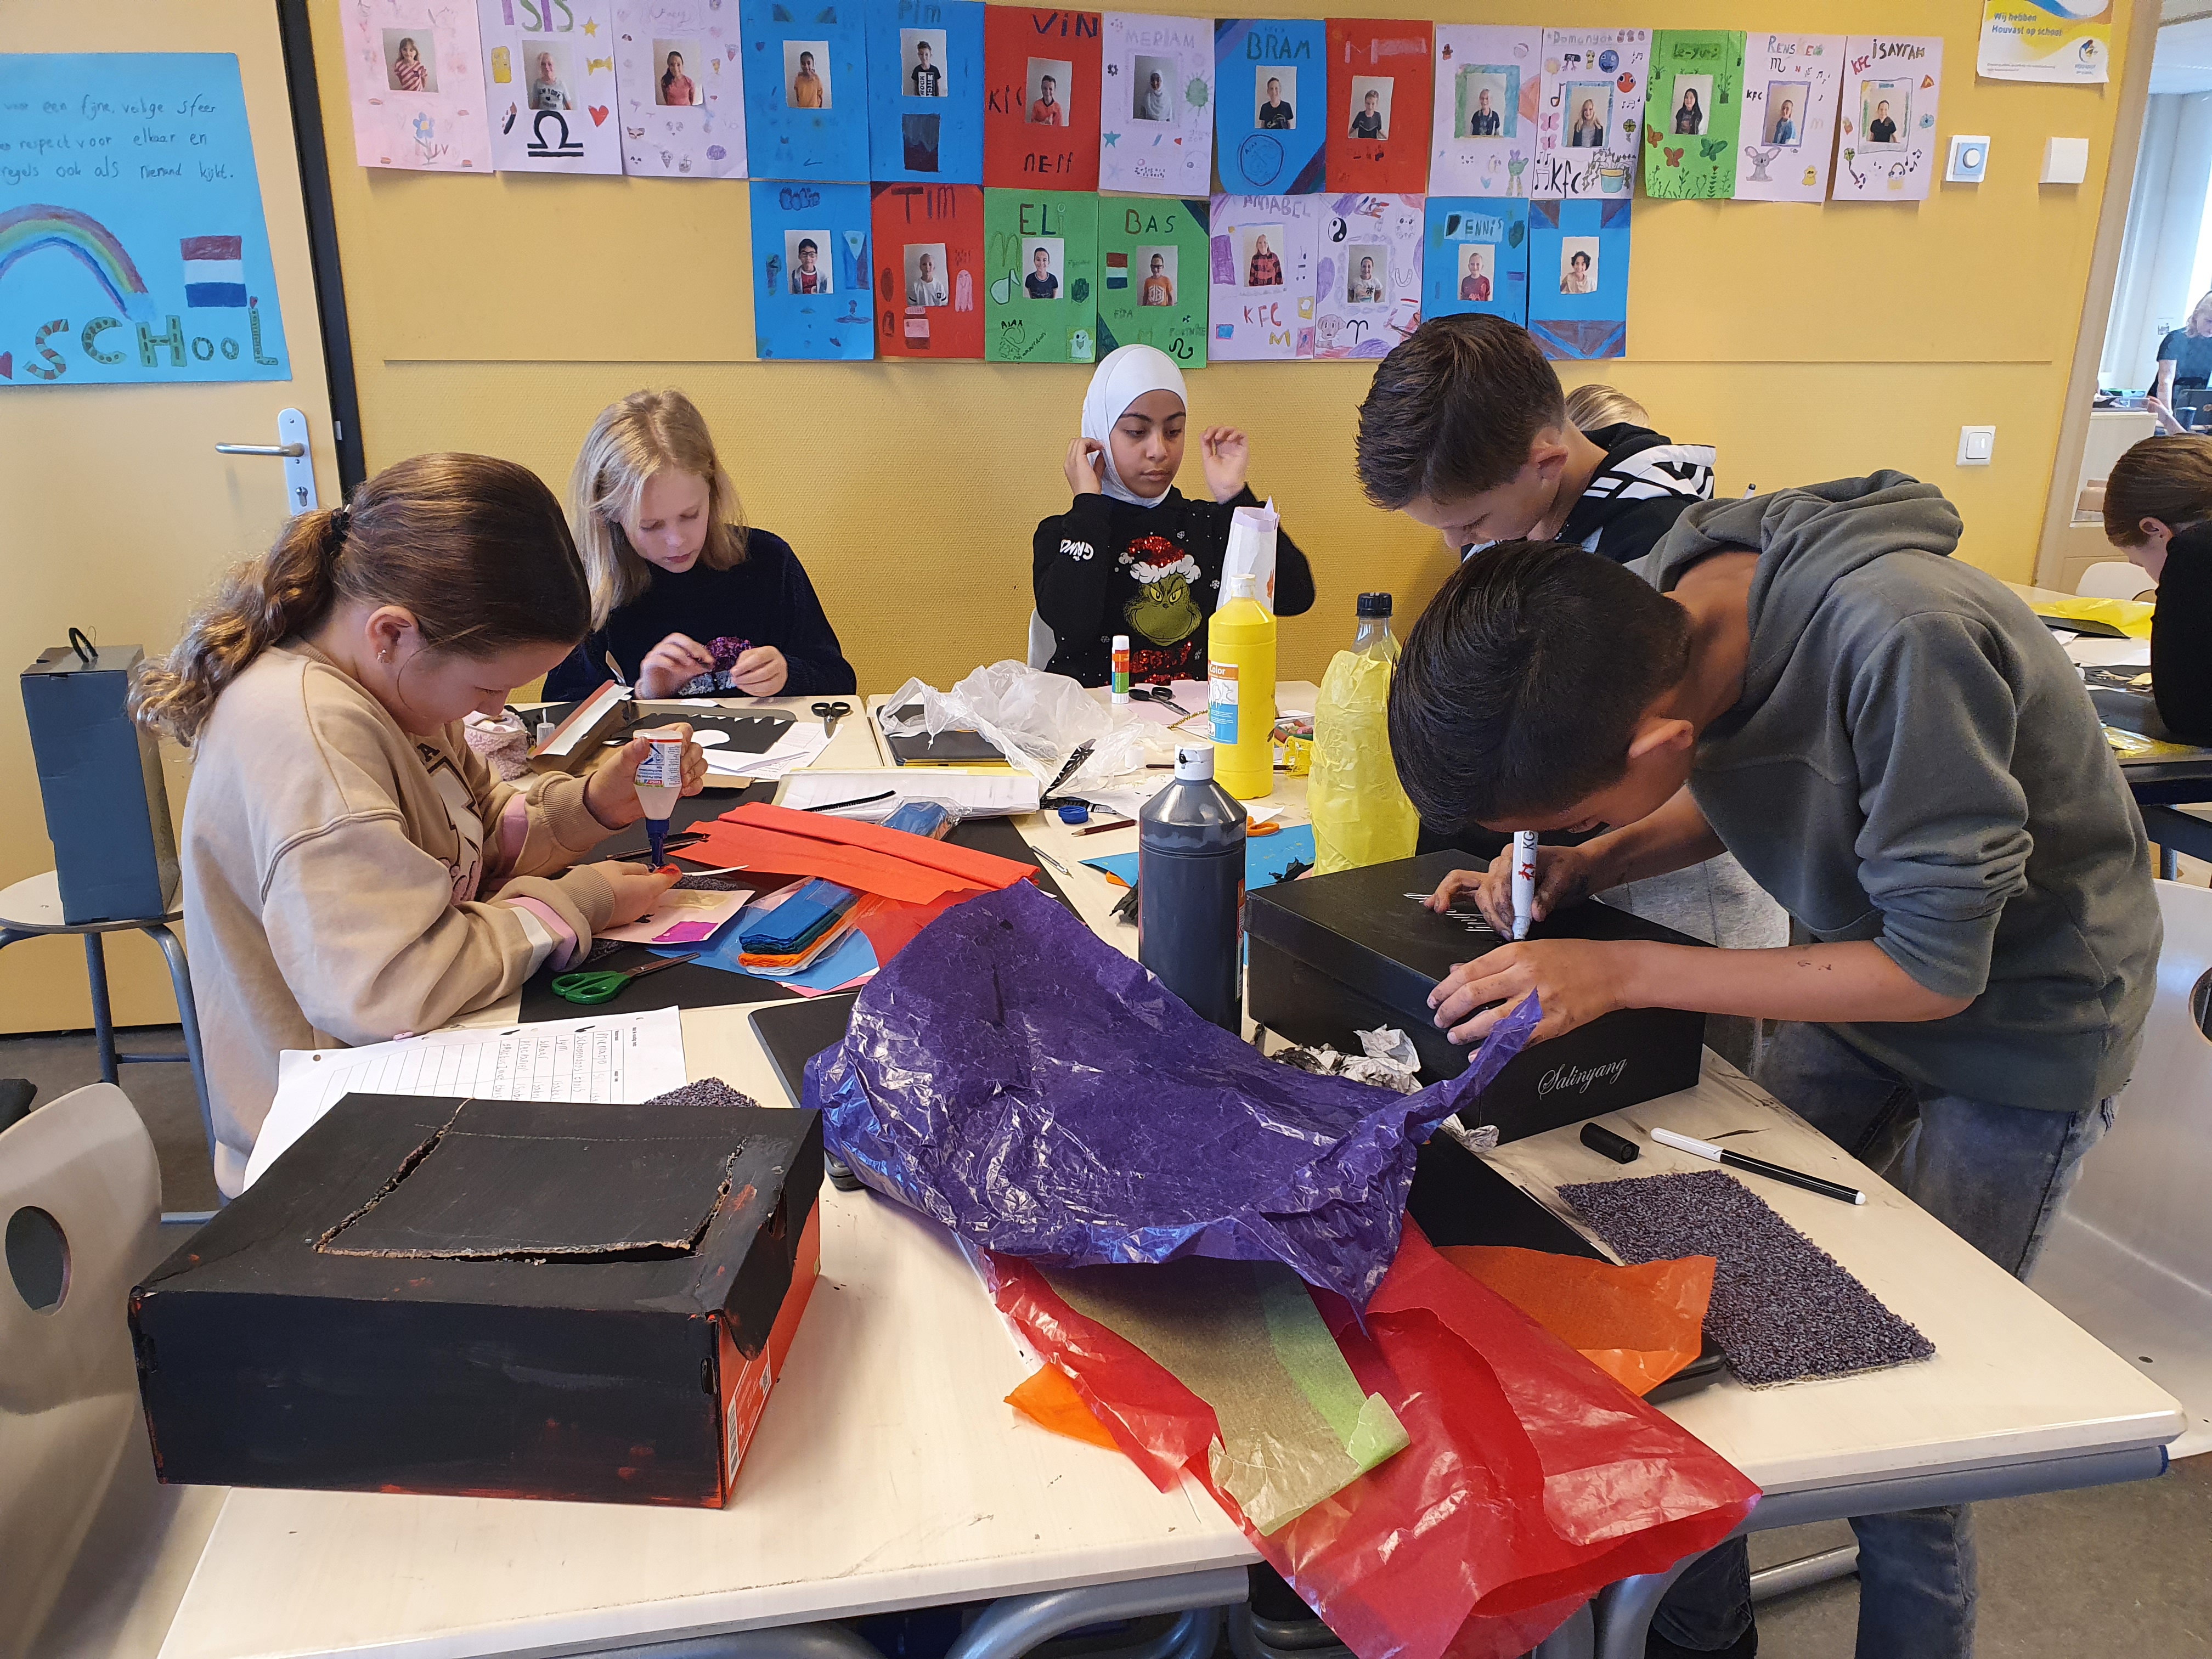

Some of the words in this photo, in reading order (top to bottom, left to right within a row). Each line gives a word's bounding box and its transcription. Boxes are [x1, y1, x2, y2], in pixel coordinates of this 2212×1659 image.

[1125, 208, 1176, 235] BAS
[1243, 302, 1282, 328] KFC
[1538, 1058, 1628, 1101] Salinyang
